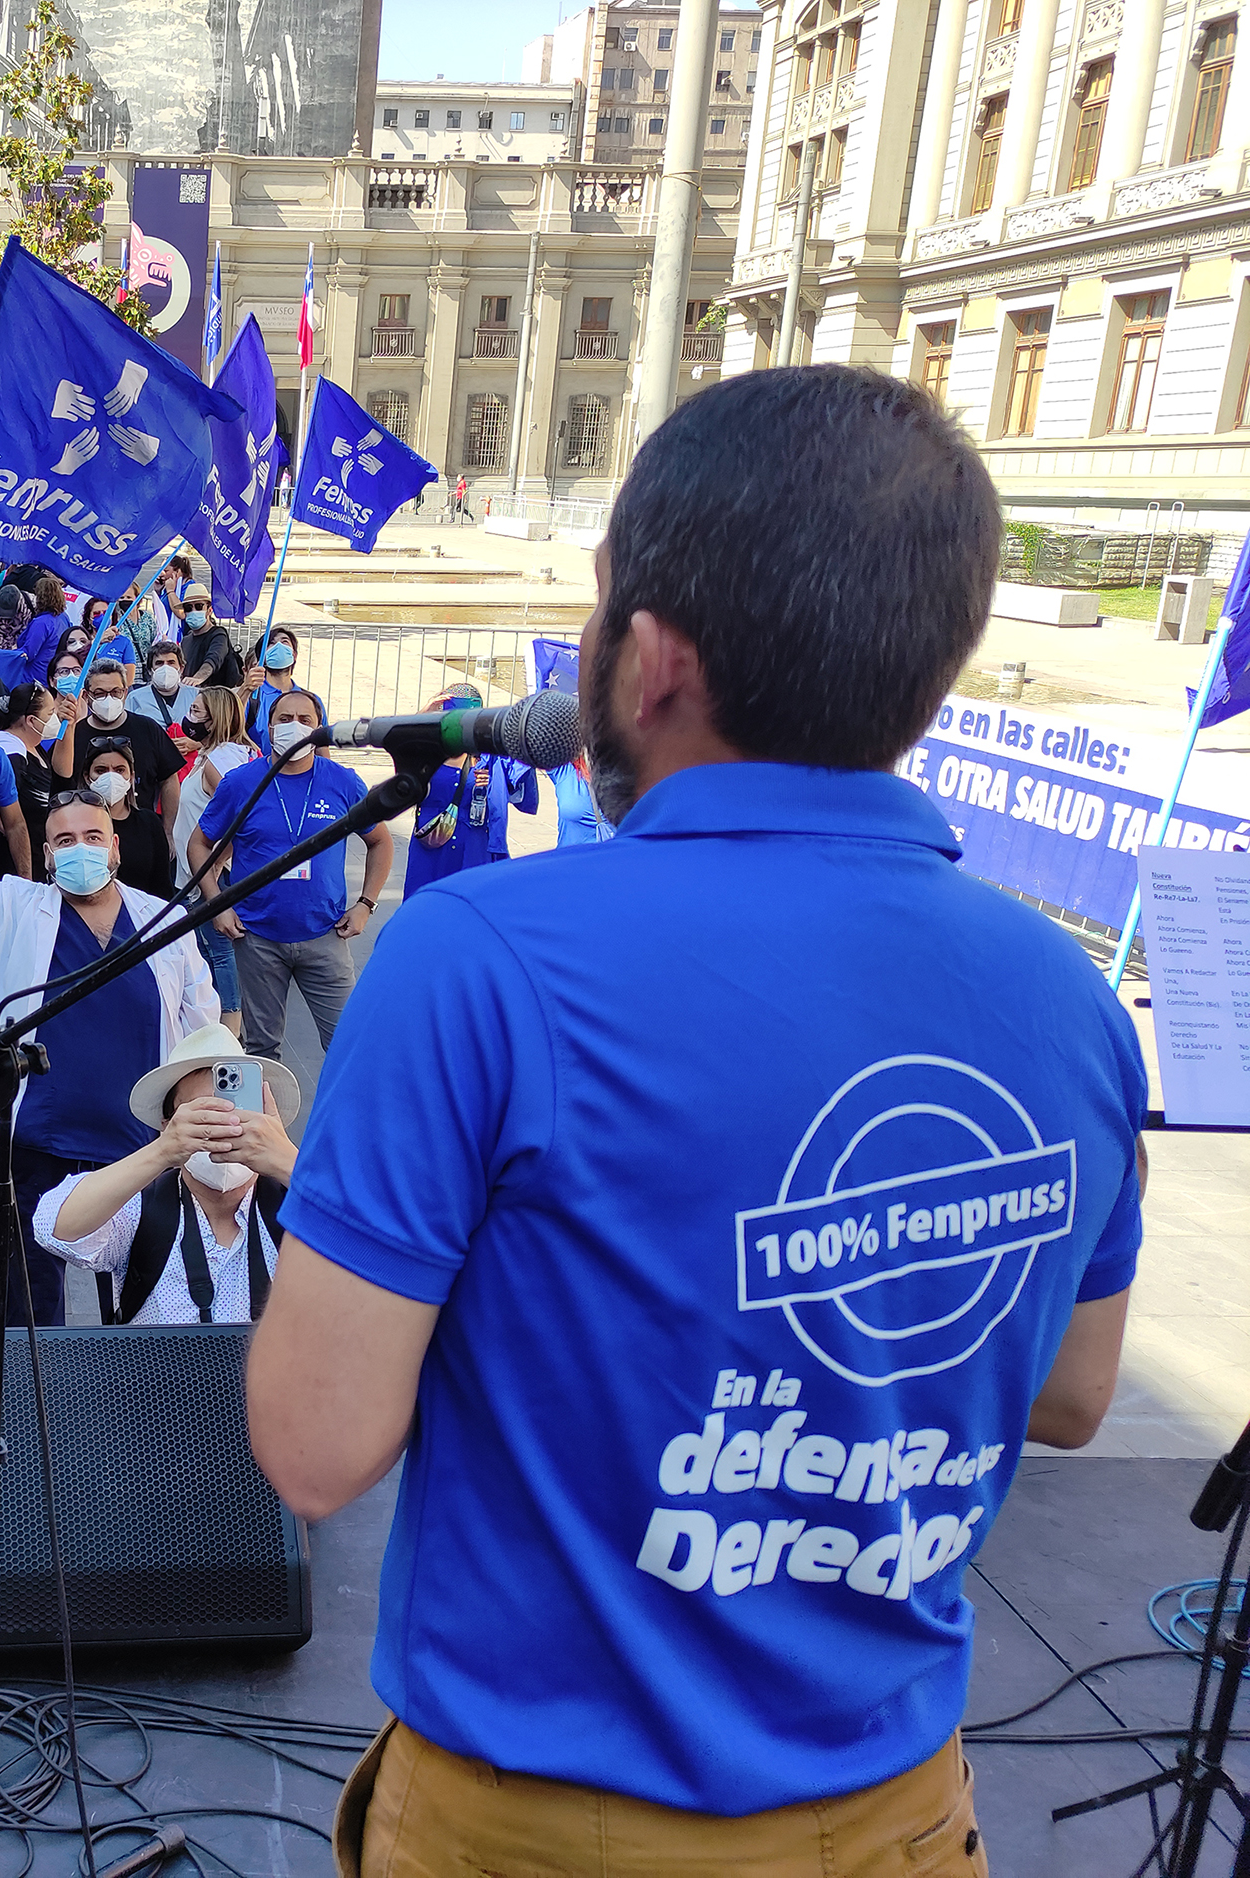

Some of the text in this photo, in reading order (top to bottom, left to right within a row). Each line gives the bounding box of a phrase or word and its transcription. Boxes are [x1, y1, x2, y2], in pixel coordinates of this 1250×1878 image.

[264, 306, 294, 315] MVSEO
[29, 525, 50, 542] DE
[46, 536, 70, 560] LA
[220, 542, 232, 559] DE
[230, 554, 241, 569] LA
[959, 710, 991, 740] en
[996, 710, 1036, 751] las
[1041, 726, 1131, 775] calles:
[936, 755, 1010, 814] OTRA
[1009, 775, 1106, 842] SALUD
[1152, 872, 1172, 880] Nueva
[1152, 882, 1192, 892] Constitución
[754, 1178, 1066, 1279] 100% Fenpruss
[712, 1368, 802, 1410] En la
[658, 1410, 950, 1504] defensa
